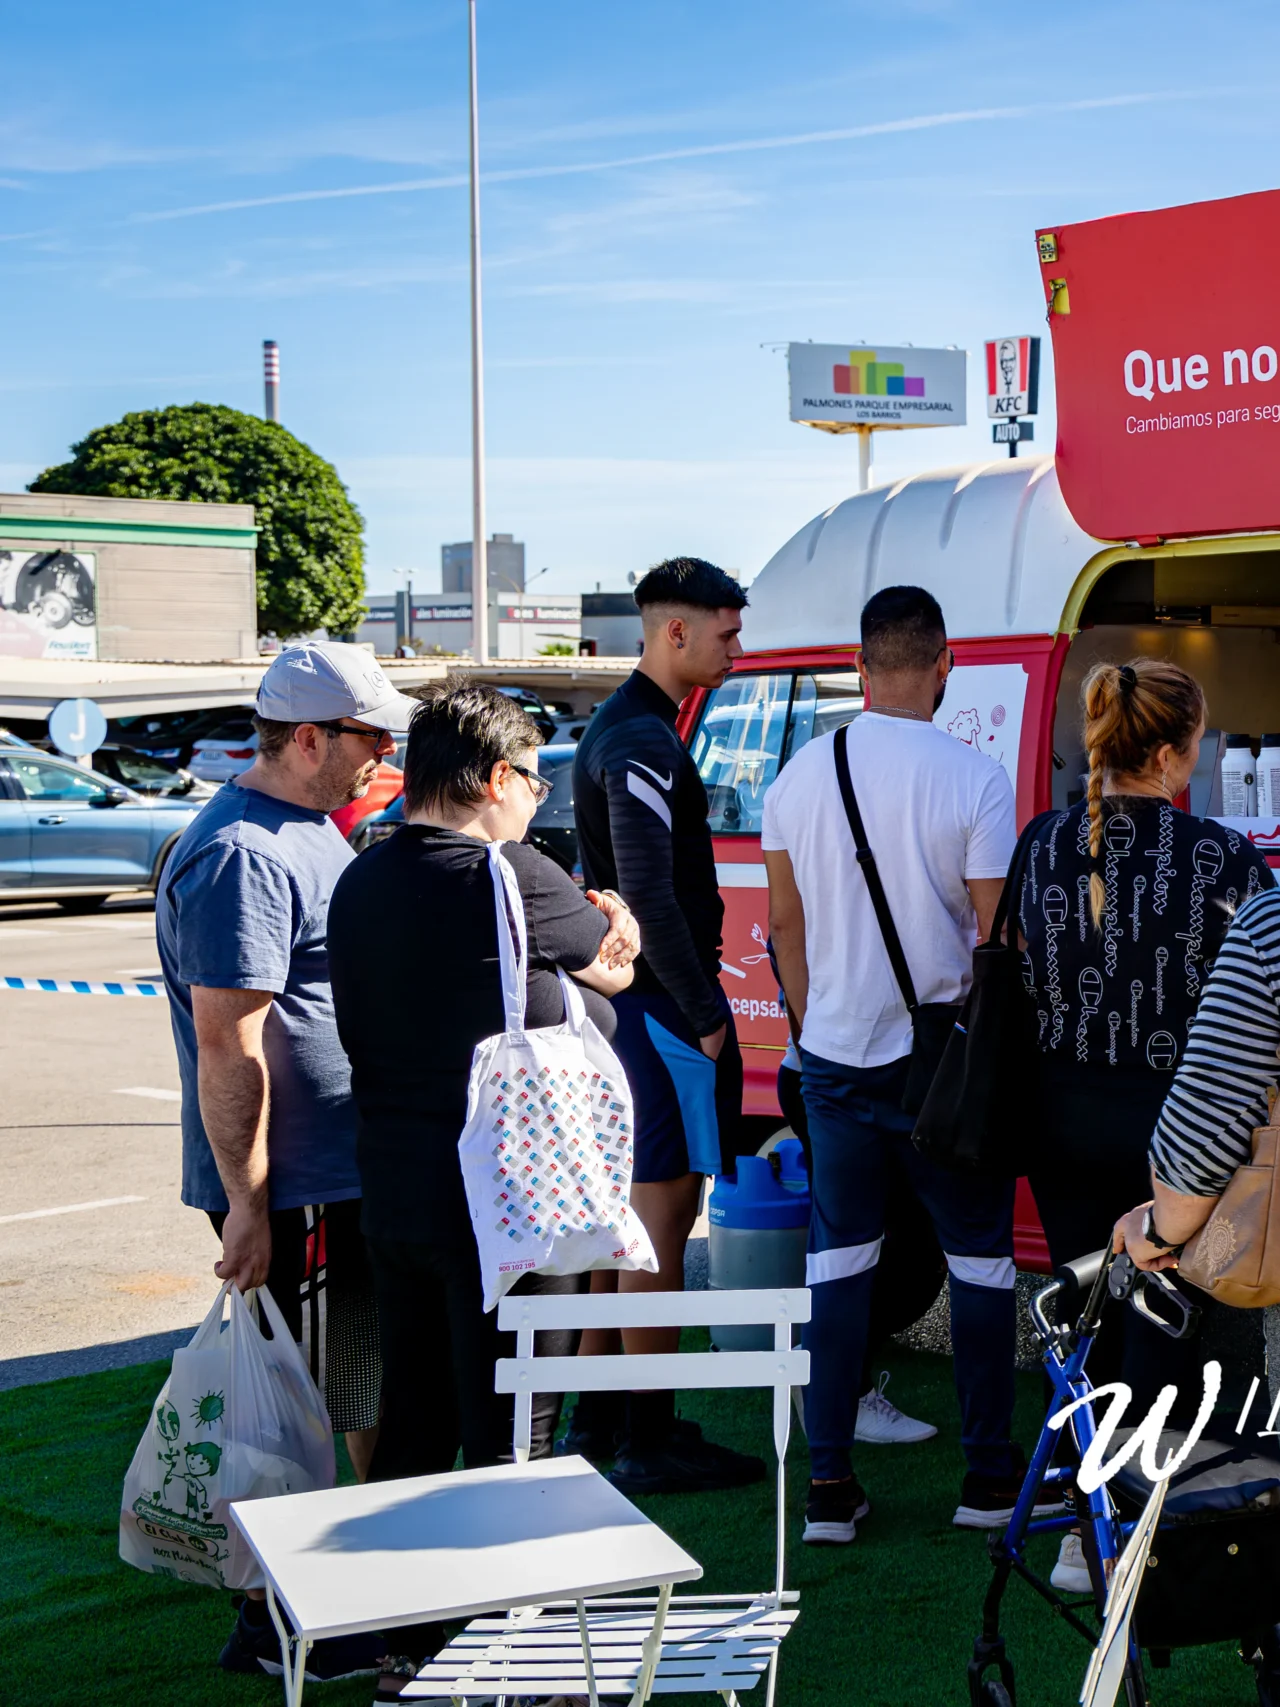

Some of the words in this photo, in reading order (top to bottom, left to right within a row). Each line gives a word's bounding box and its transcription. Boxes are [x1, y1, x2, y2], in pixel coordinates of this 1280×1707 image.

[803, 398, 852, 409] PALMONES
[855, 400, 890, 411] PARQUE
[893, 401, 954, 412] EMPRESARIAL
[995, 396, 1022, 413] KFC
[1123, 349, 1209, 401] Que
[1222, 345, 1278, 385] no
[857, 410, 870, 418] LOS
[871, 411, 902, 419] BARRIOS
[995, 424, 1020, 441] AUTO
[1126, 412, 1213, 434] Cambiamos
[1216, 406, 1250, 428] para
[69, 712, 86, 741] J
[1074, 875, 1091, 941] Champion
[1104, 813, 1136, 977] Champion
[1128, 875, 1147, 942] Champion
[1176, 839, 1224, 997] Champion
[1042, 884, 1070, 1050] Champion
[1154, 947, 1170, 1015] Champion
[1077, 966, 1104, 1062] Cham
[1126, 979, 1144, 1047] Champion
